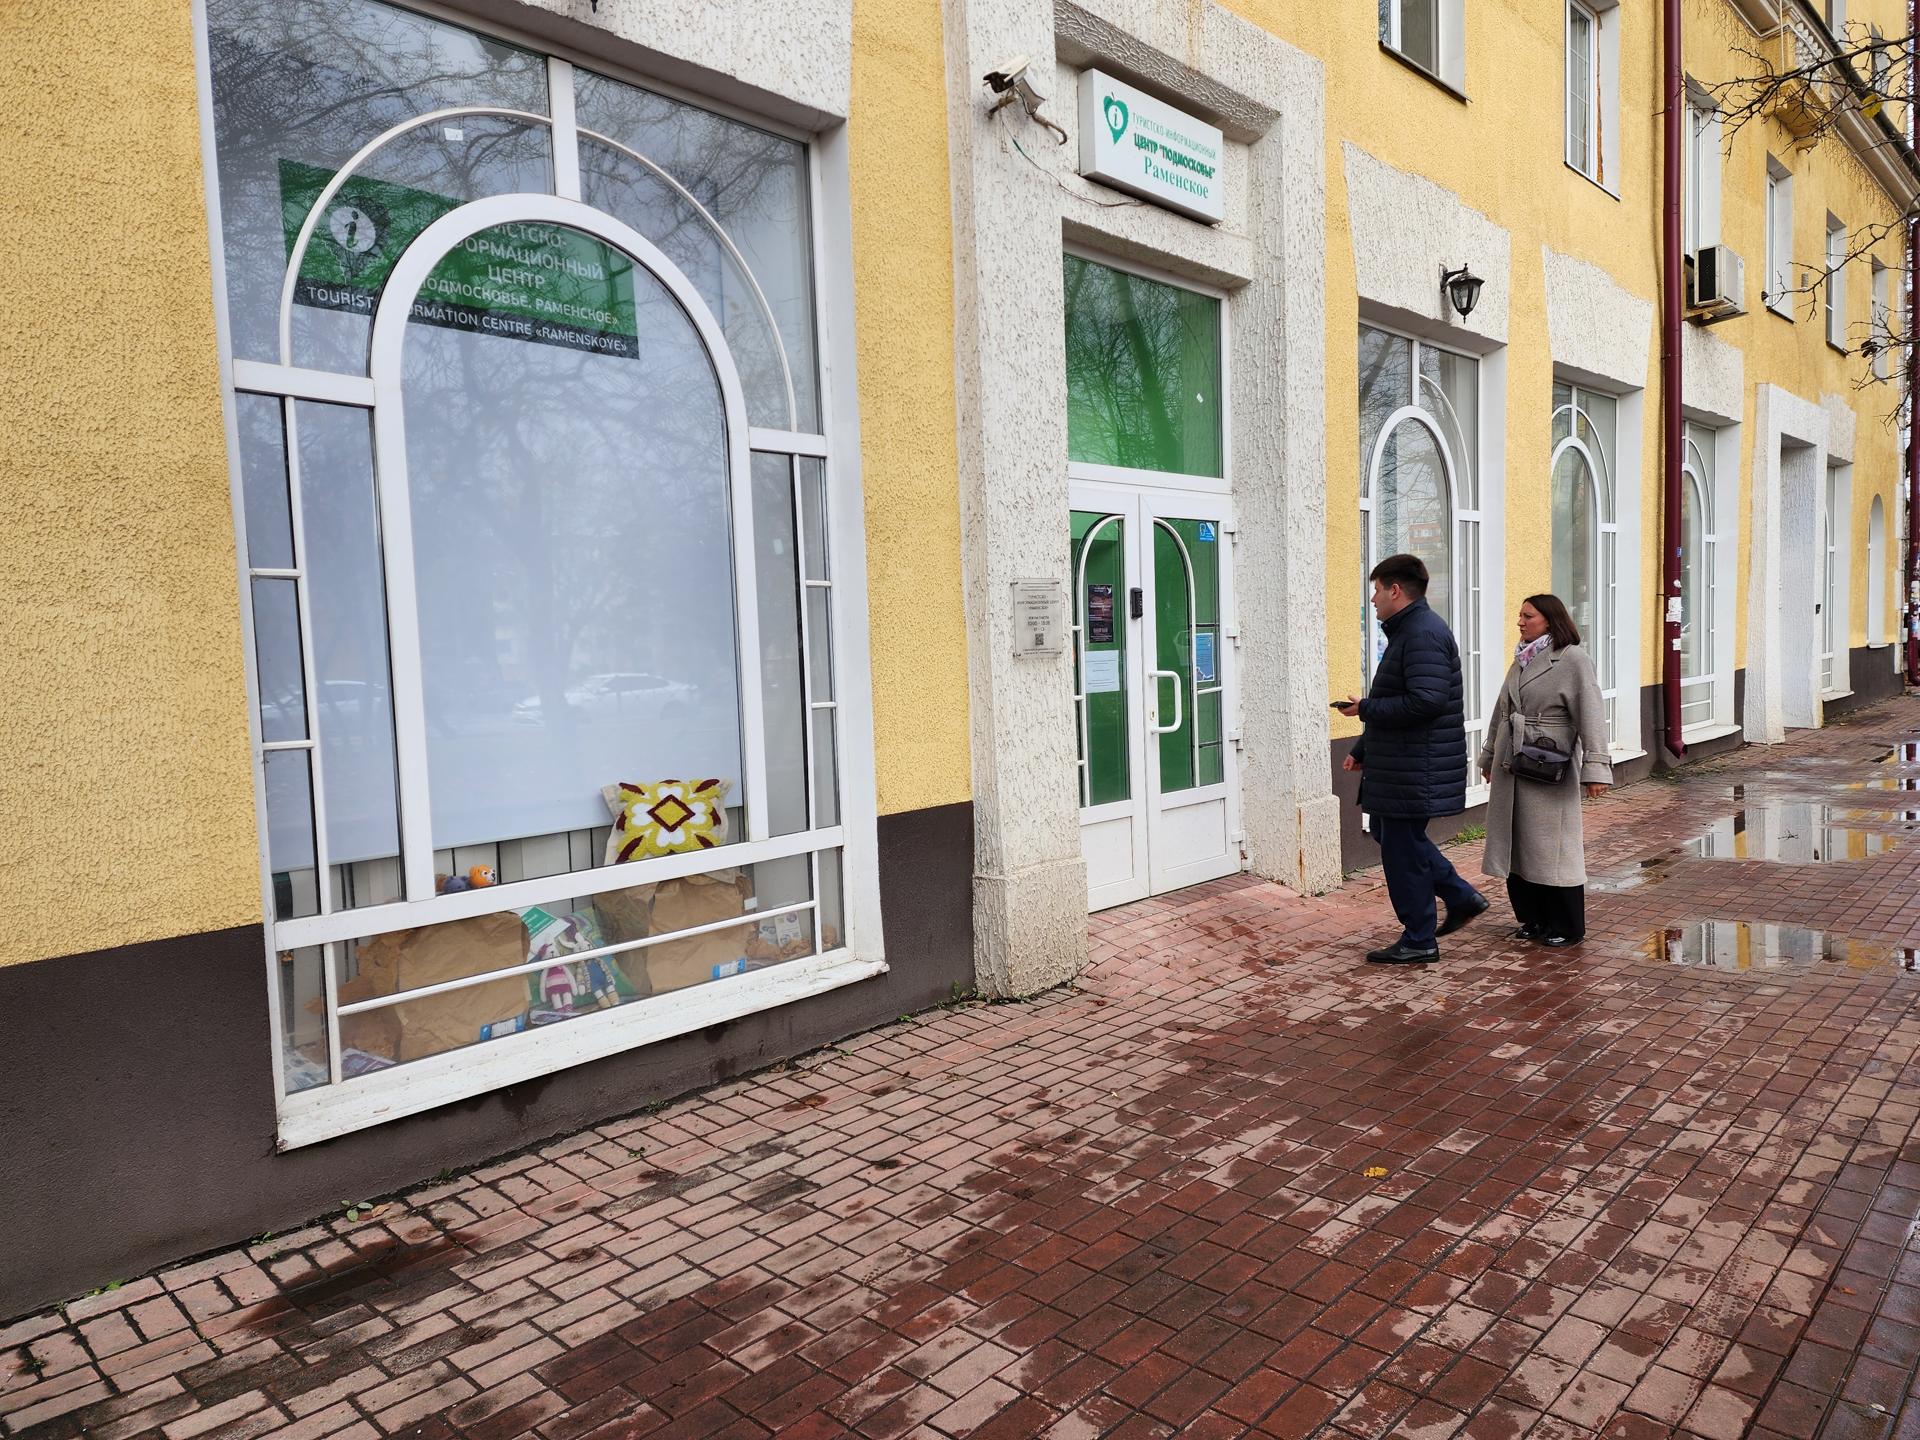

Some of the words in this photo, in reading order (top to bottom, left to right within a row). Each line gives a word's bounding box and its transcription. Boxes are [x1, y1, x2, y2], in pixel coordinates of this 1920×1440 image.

[1133, 132, 1158, 154] ЦЕНТР
[1144, 156, 1209, 199] Раменское
[493, 223, 567, 248] ИСТСКО-
[456, 237, 604, 280] ОРМАЦИОННЫЙ
[487, 264, 545, 289] ЦЕНТР
[307, 286, 375, 308] TOURIST
[408, 304, 478, 326] RMATION
[482, 316, 532, 335] CENTRE
[535, 326, 628, 351] «RAMENSKOYE»
[420, 278, 532, 308] ОДМОСКОВЬЕ.
[535, 299, 618, 325] РАМЕНСКОЕ»
